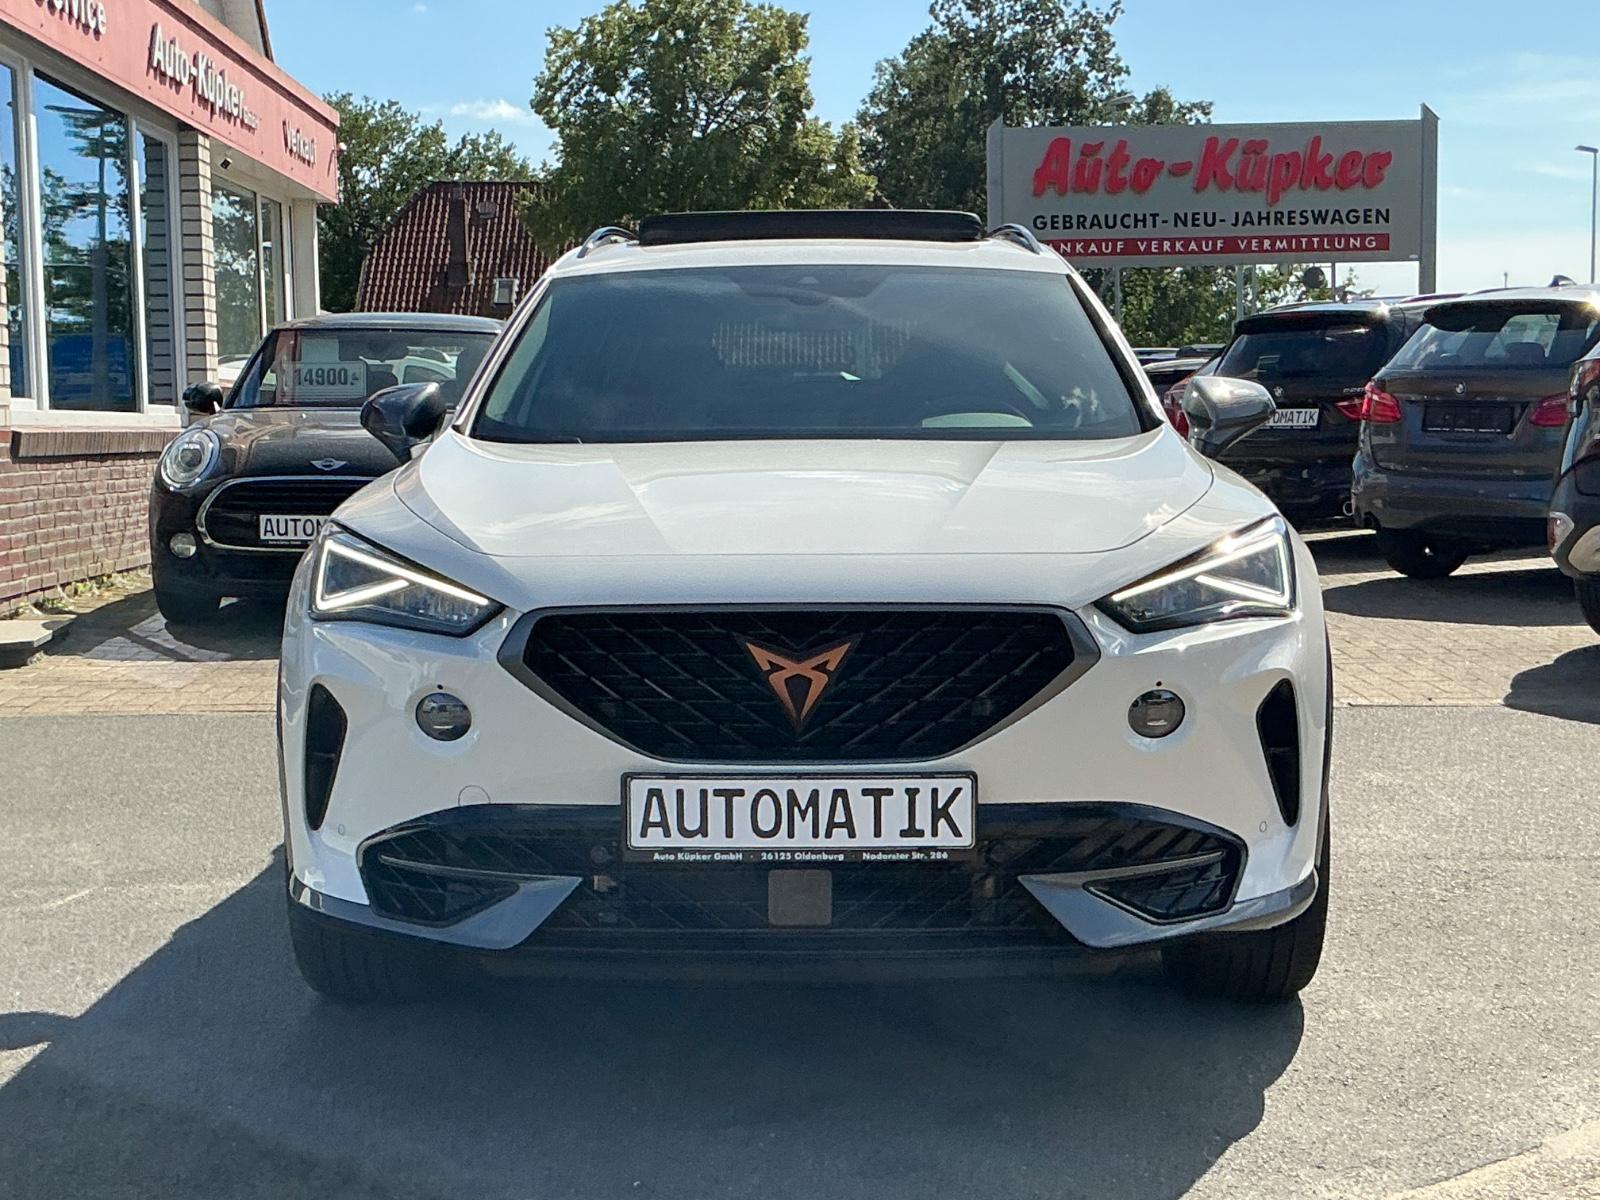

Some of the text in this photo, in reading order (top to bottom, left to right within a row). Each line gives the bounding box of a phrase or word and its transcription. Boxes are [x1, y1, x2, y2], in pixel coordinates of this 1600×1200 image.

[1137, 239, 1225, 253] VERKAUF
[1237, 236, 1377, 250] VERMITTLUNG
[1268, 410, 1317, 424] OMATIK
[640, 787, 963, 839] AUTOMATIK
[653, 852, 675, 861] Auto
[677, 852, 711, 862] Küpker
[714, 852, 743, 861] GmbH
[761, 852, 792, 861] 26125
[794, 851, 844, 861] Oldenburg
